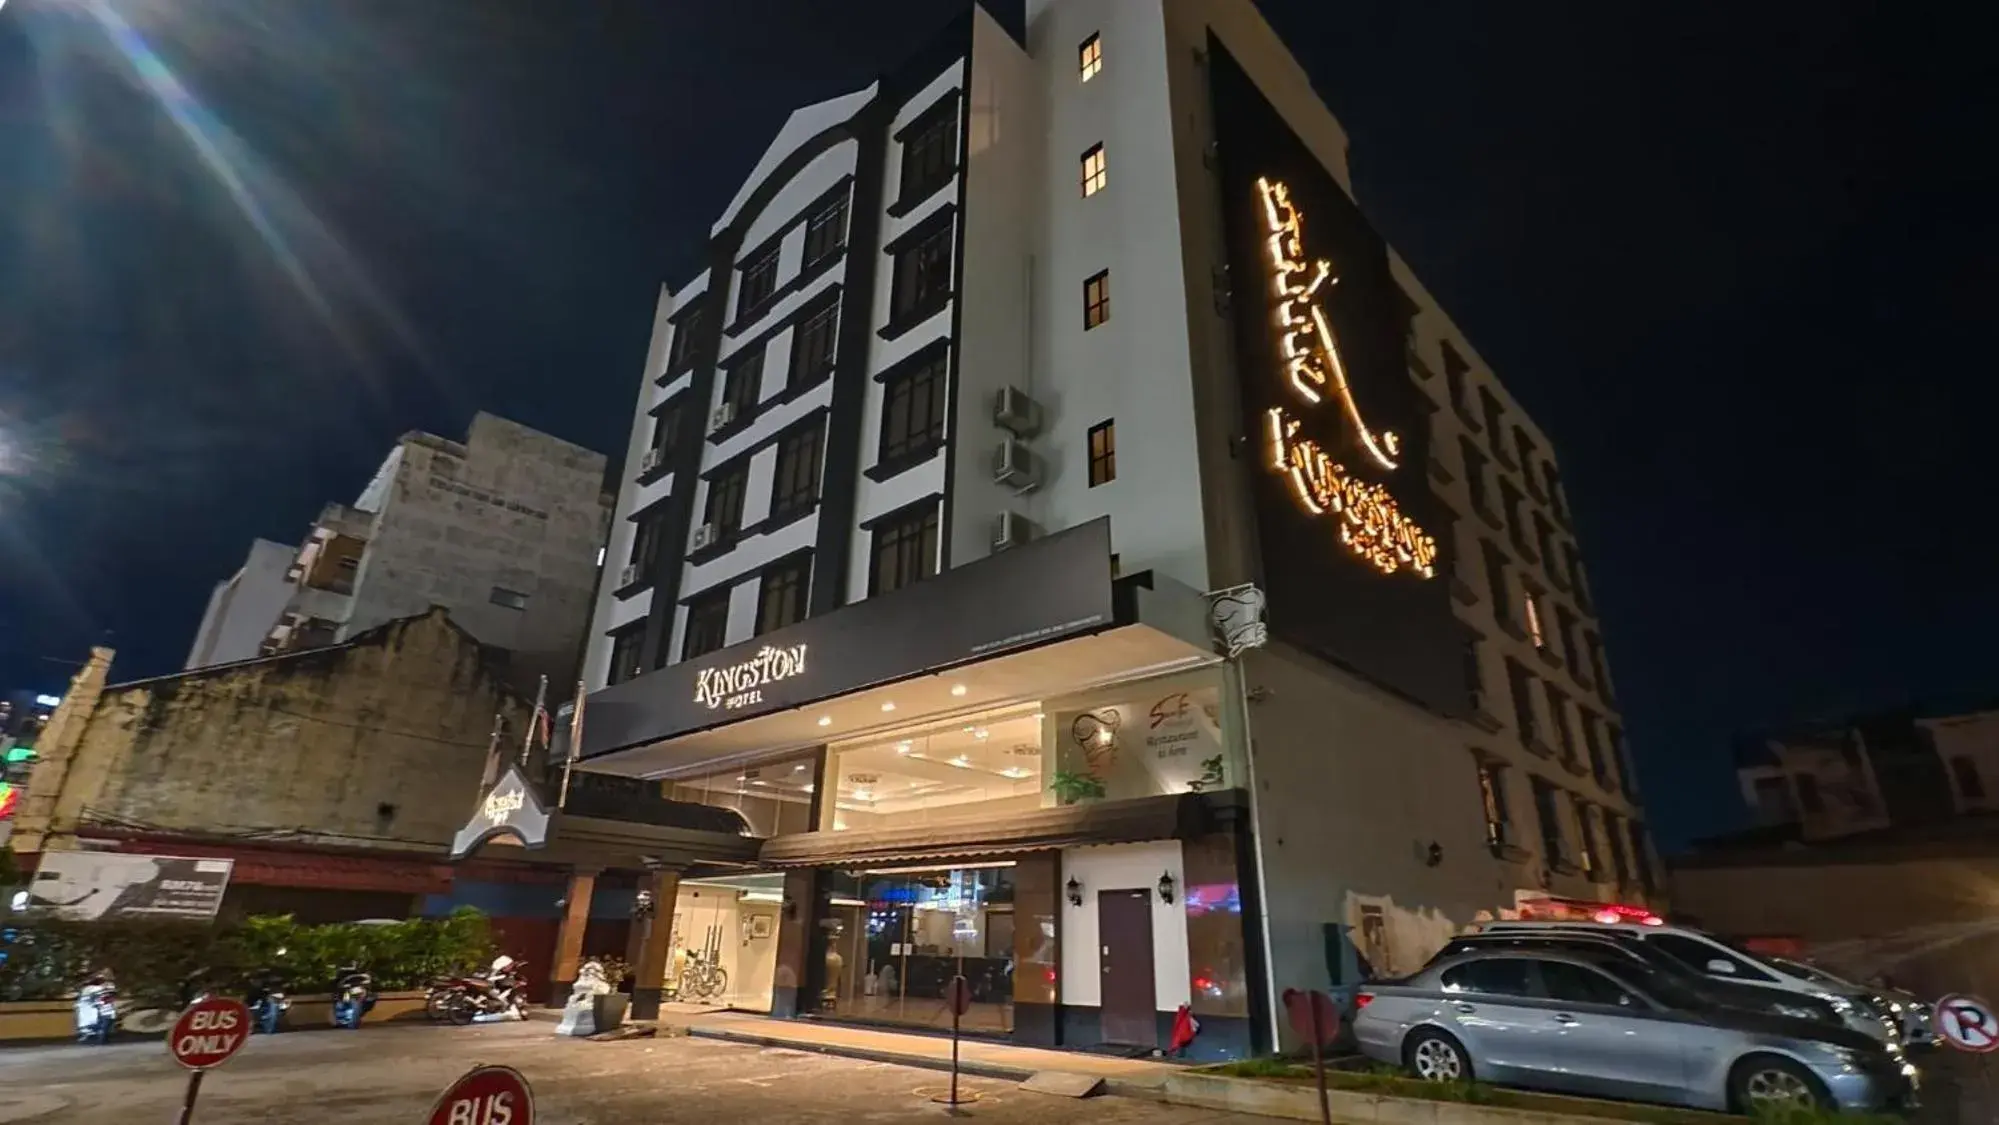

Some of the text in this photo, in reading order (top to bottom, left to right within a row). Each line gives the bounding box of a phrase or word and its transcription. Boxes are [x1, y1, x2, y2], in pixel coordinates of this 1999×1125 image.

[693, 643, 807, 709] KINGSTON
[726, 690, 763, 709] HOTEL
[191, 1010, 238, 1030] BUS
[177, 1034, 240, 1055] ONLY
[448, 1090, 514, 1125] BUS
